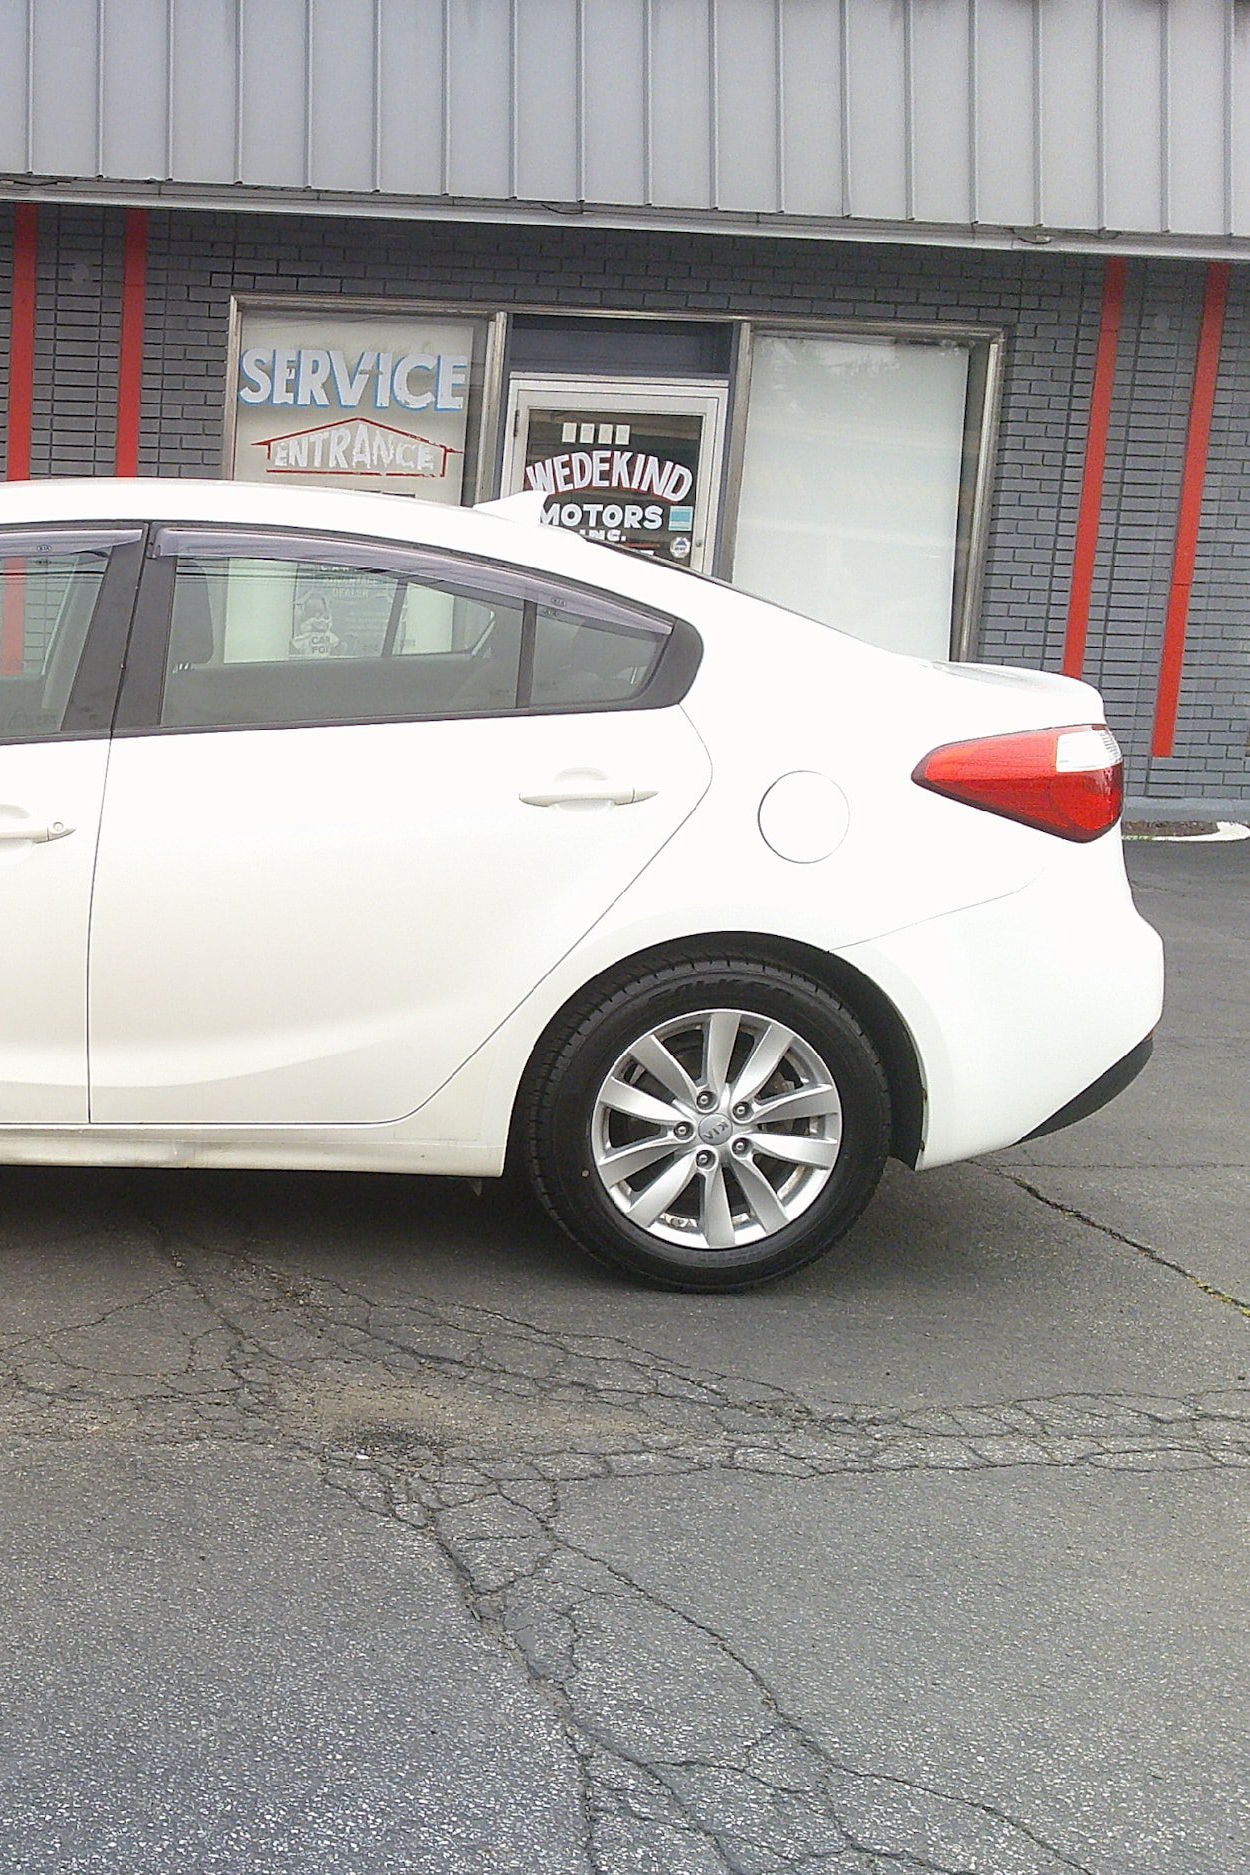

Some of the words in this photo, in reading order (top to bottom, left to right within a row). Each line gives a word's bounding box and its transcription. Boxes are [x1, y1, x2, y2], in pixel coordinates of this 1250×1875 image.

[239, 349, 468, 412] SERVICE
[274, 423, 434, 470] ENTRANCE
[526, 450, 693, 502] WEDEKIND
[540, 503, 663, 529] MOTORS
[703, 1120, 728, 1139] KIA
